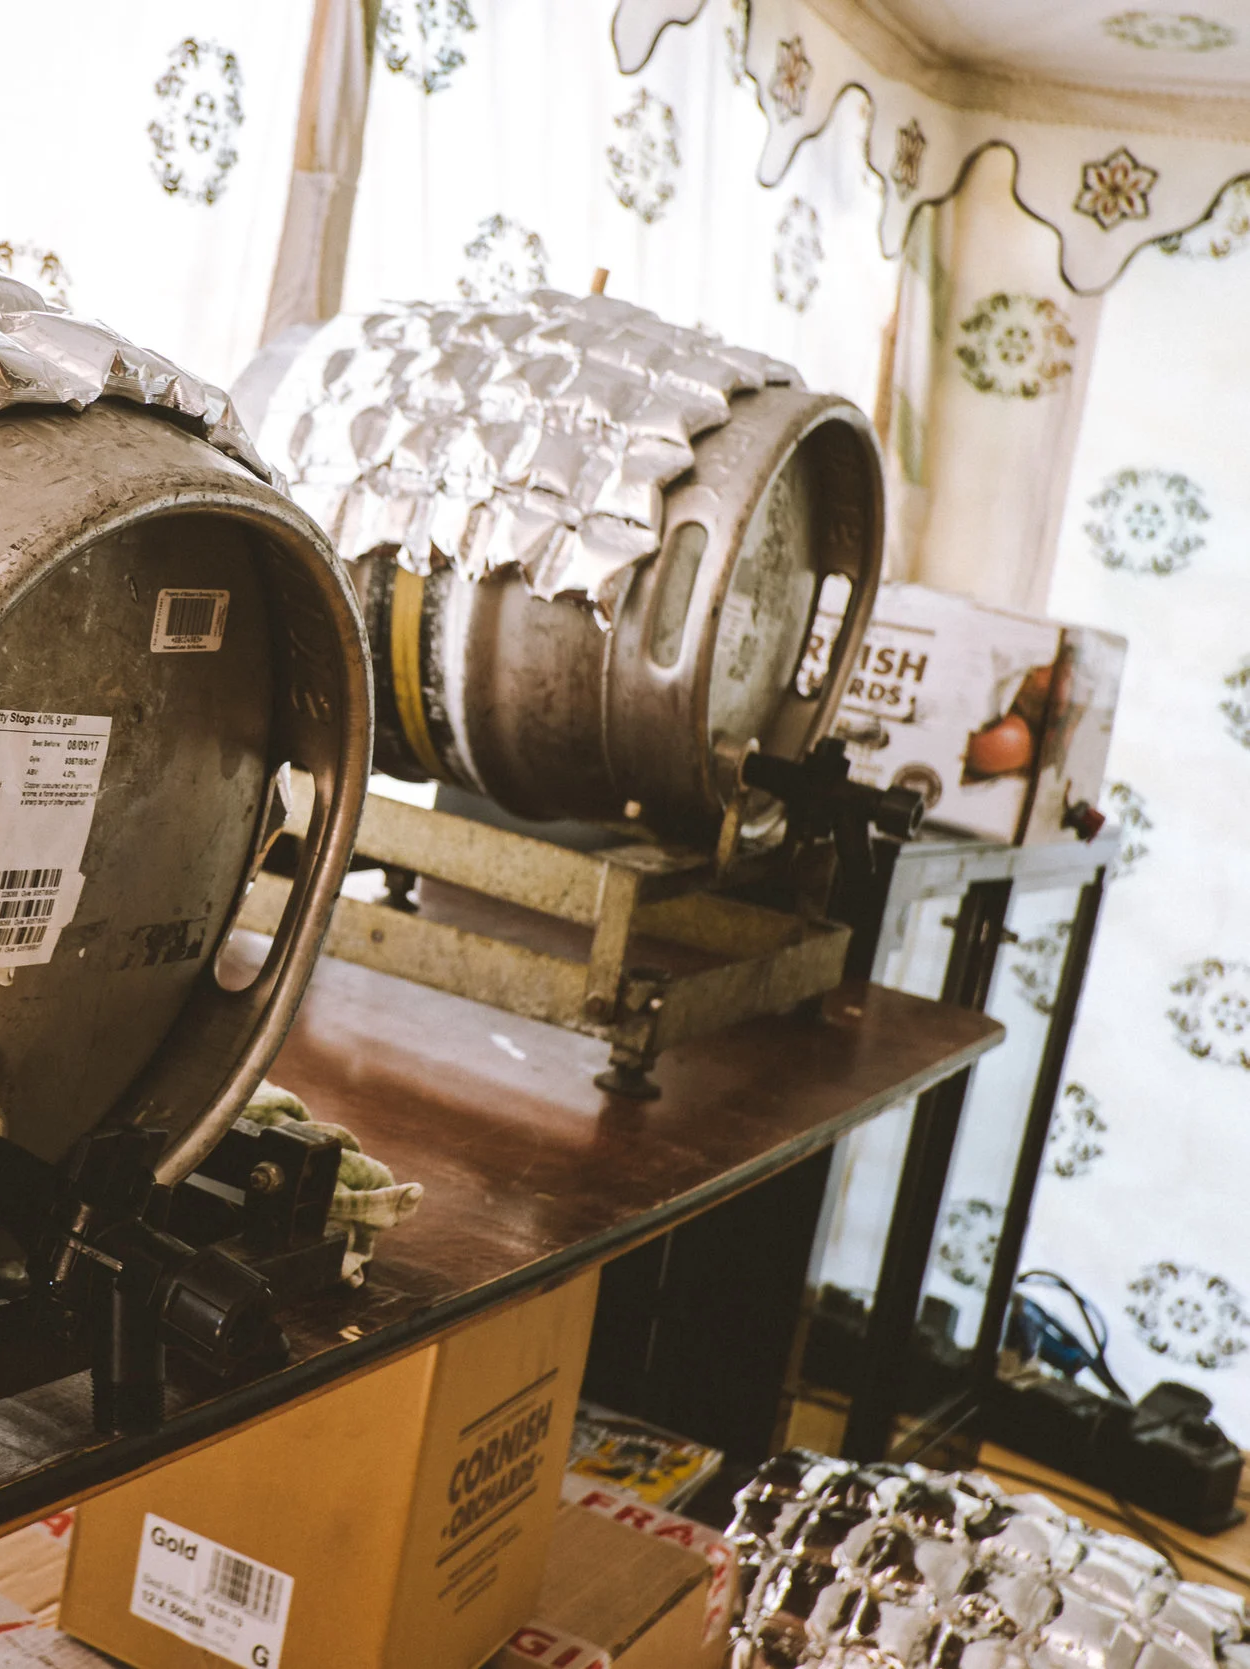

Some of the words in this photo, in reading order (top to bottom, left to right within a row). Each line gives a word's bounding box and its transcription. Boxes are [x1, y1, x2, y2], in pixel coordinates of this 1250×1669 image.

[10, 712, 35, 726] Stogs
[37, 714, 54, 725] 4.0%
[55, 715, 62, 725] 9
[62, 715, 77, 729] gall
[67, 740, 99, 751] 08/09/17
[62, 770, 76, 778] 4.0%
[447, 1400, 554, 1505] CORNISH
[151, 1526, 198, 1561] Gold
[141, 1589, 156, 1604] 12
[251, 1644, 270, 1669] G
[508, 1627, 607, 1669] GI
